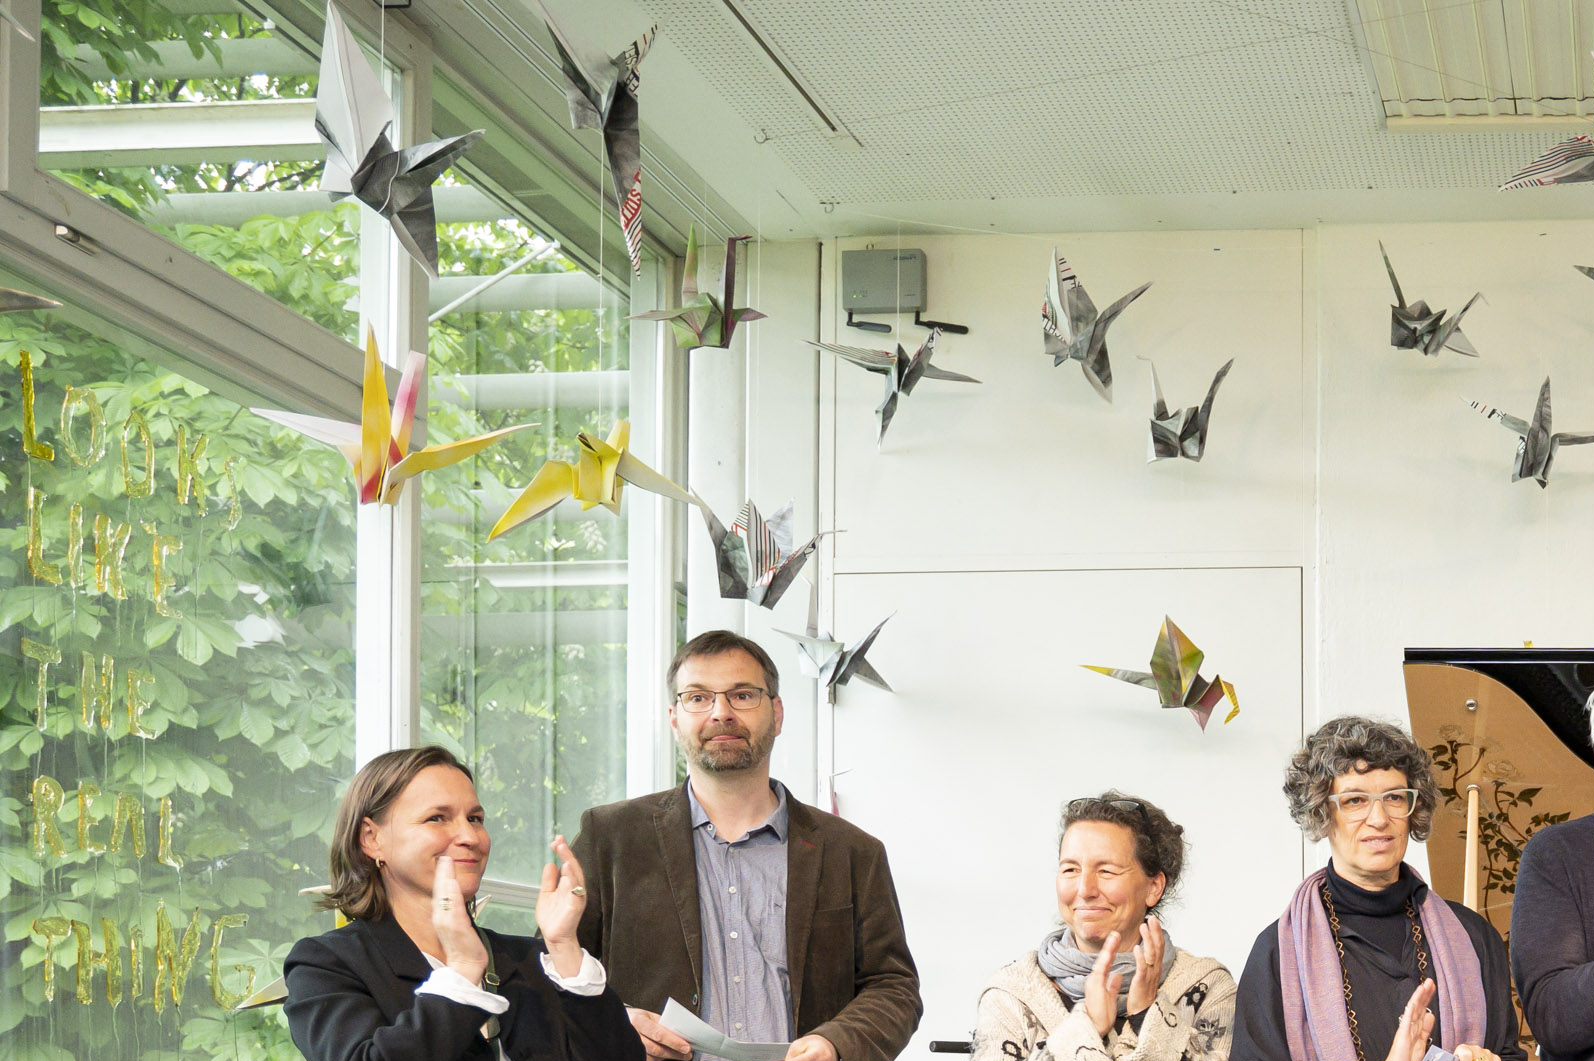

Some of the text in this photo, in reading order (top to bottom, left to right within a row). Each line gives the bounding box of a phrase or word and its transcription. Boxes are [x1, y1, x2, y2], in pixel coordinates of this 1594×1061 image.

[28, 487, 183, 618] LIKE
[22, 637, 157, 739] THE
[32, 775, 184, 871] REAL
[33, 899, 256, 1014] THING
